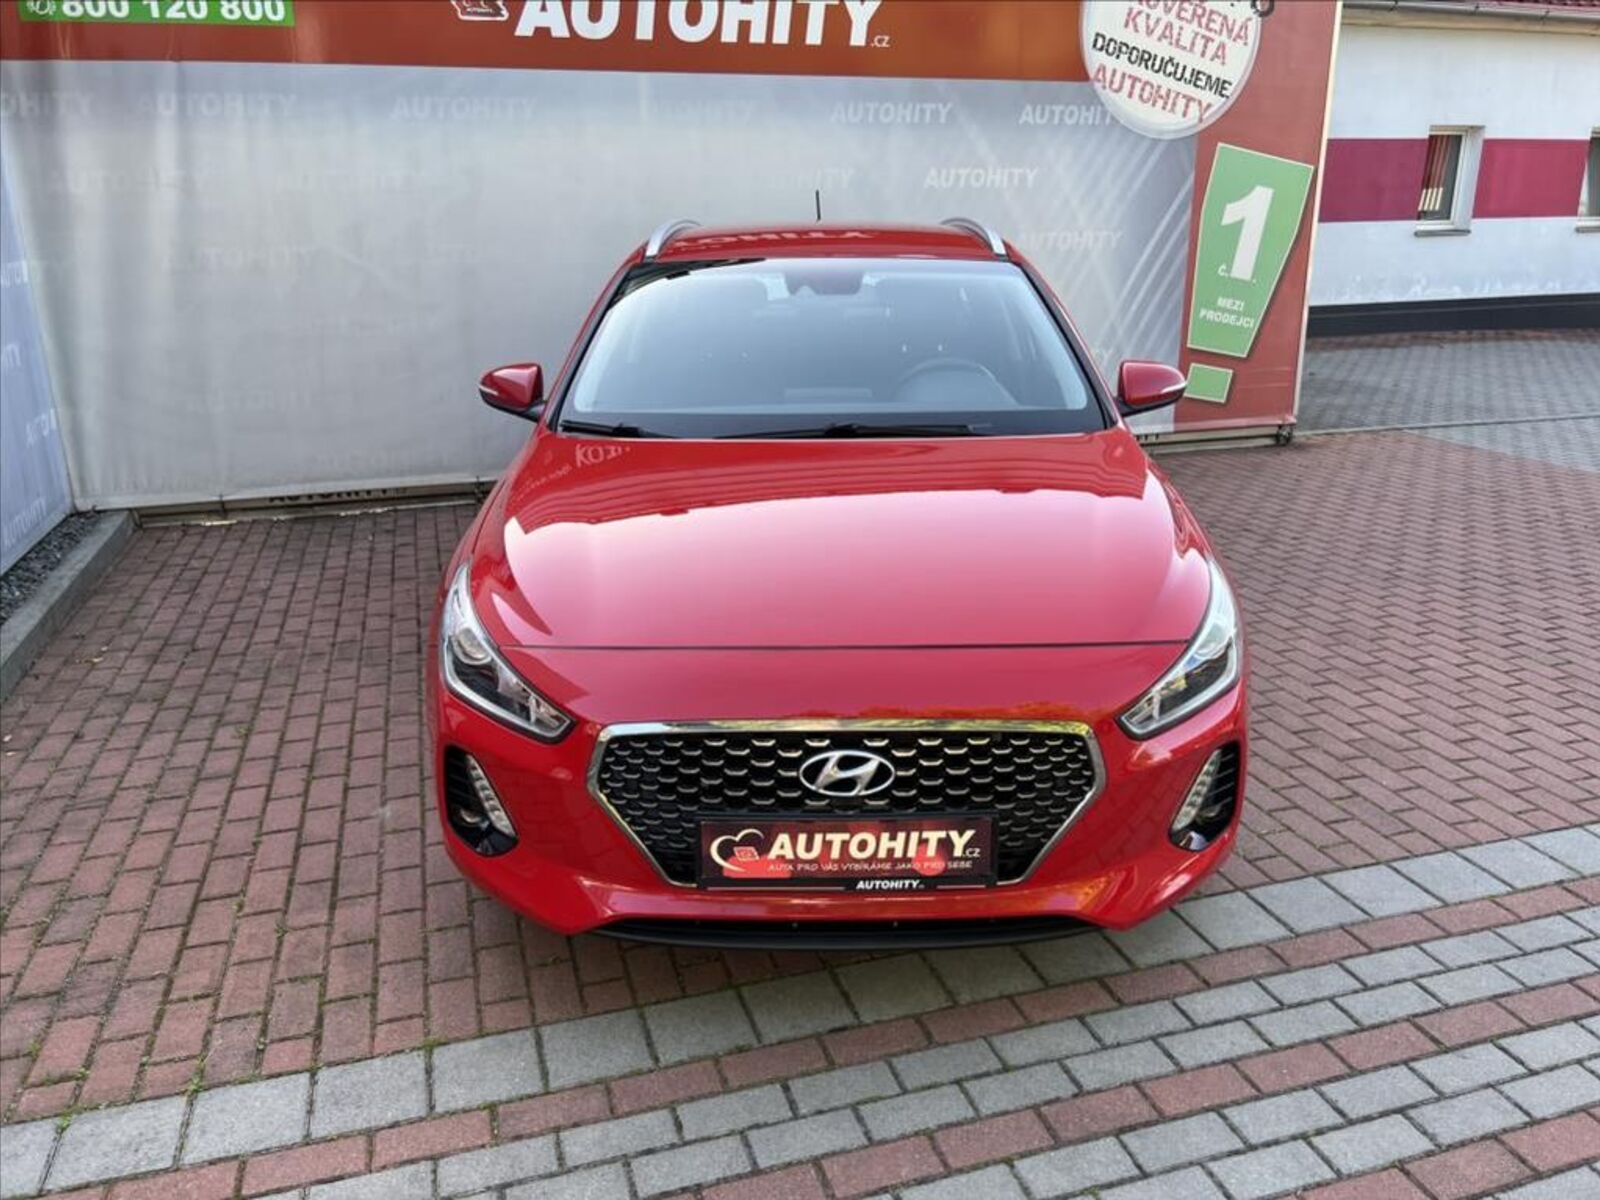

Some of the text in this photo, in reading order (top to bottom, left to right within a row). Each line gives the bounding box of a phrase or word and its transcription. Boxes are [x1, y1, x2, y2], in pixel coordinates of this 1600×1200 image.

[220, 0, 285, 21] 800
[1124, 7, 1226, 66] KVALITA
[1092, 32, 1233, 99] DOPORUČUJEME
[1093, 63, 1212, 123] AUTOHITY
[830, 102, 953, 124] AUTOHITY
[1018, 104, 1114, 127] AUTOHIT
[923, 167, 1038, 189] AUTOHITY
[1217, 297, 1245, 311] MEZI
[1199, 308, 1255, 329] PRODEJCI
